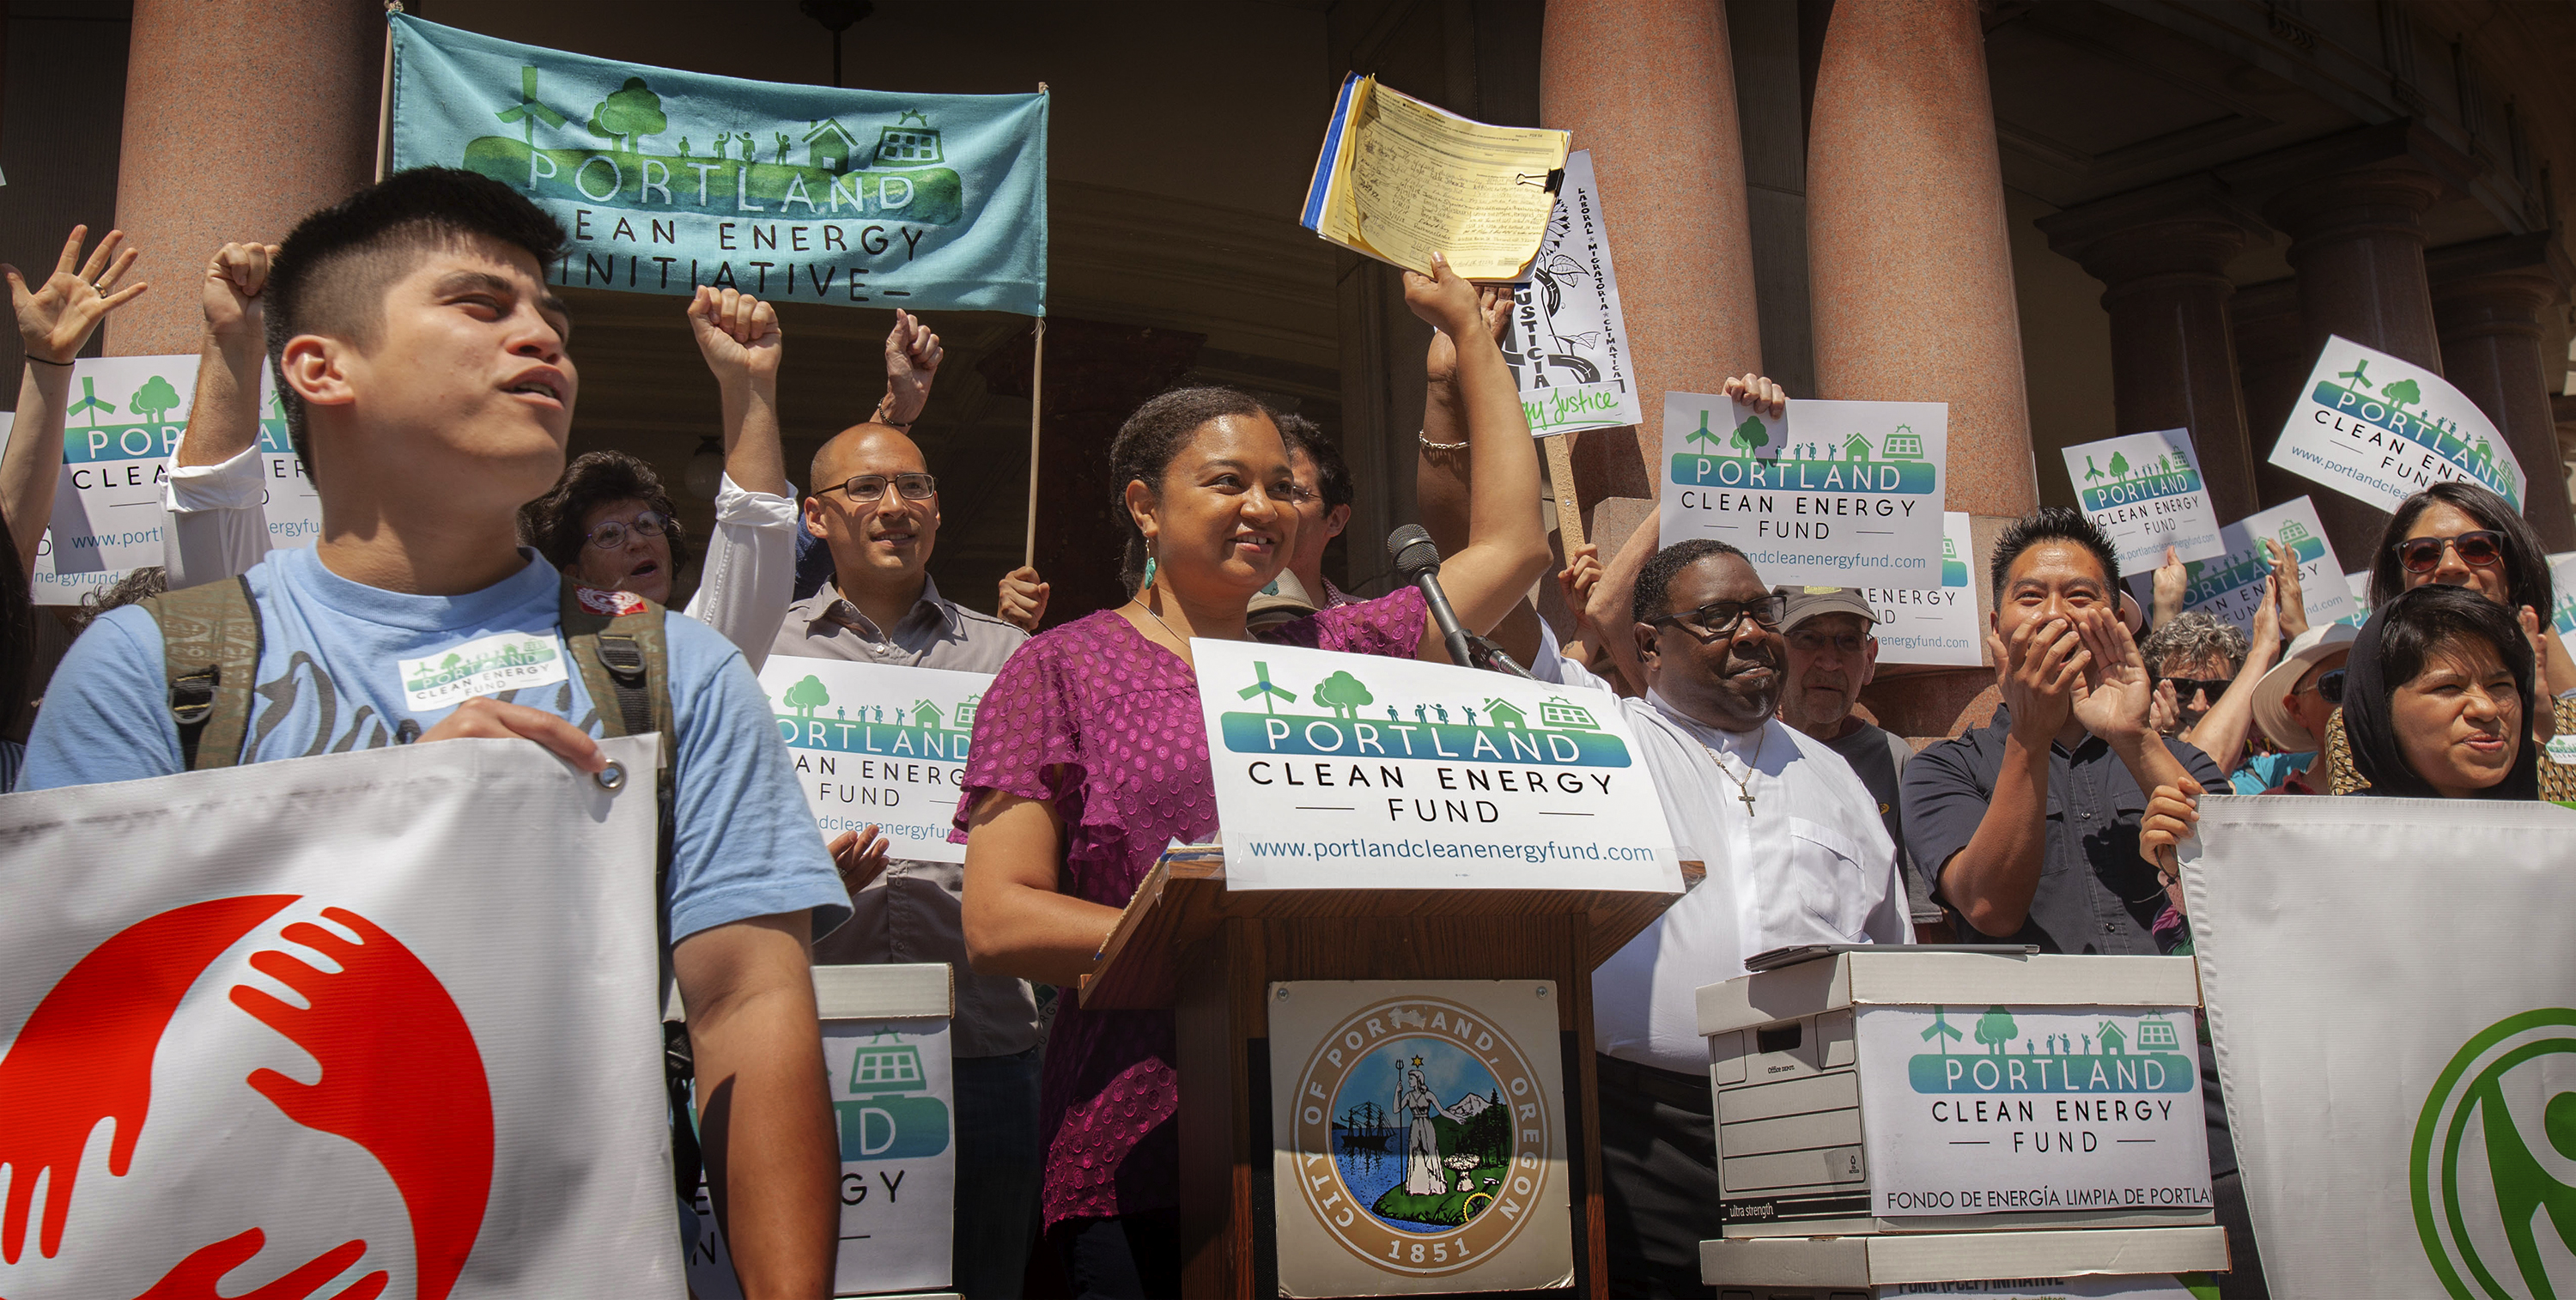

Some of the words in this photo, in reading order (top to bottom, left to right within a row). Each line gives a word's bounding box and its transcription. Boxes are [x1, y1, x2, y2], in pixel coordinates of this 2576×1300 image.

[529, 149, 914, 213] PORTLAND
[574, 209, 675, 246] EAN
[720, 222, 924, 261] ENERGY
[1577, 187, 1594, 235] LABORAL
[1588, 244, 1608, 312] MIGRATORIA
[561, 256, 869, 303] INITIATIVE
[1514, 290, 1551, 389] USTICIA
[1549, 385, 1619, 425] Justice
[2314, 410, 2405, 455] CLEAN
[2421, 453, 2480, 487] ENE
[2336, 391, 2506, 496] PORTLAND
[1696, 458, 1901, 491] PORTLAND
[2291, 445, 2409, 501] www.portlandclea
[2381, 456, 2439, 488] FUN
[1681, 490, 1773, 514] CLEAN
[1796, 496, 1916, 518] ENERGY
[2096, 473, 2188, 507] PORTLAND
[2098, 505, 2148, 526] CLEAN
[2154, 495, 2199, 515] ENERGY
[2144, 518, 2177, 535] FUND
[1759, 520, 1830, 540] FUND
[1744, 549, 1927, 571] ndcleanenergyfund.com
[2183, 548, 2302, 605] ORTLA
[1868, 587, 1956, 606] ENERGY
[2222, 604, 2259, 624] FUN
[416, 677, 472, 700] CLEAN
[483, 663, 550, 683] ENERGY
[422, 653, 539, 689] PORTAND
[464, 680, 507, 696] FUND
[1265, 718, 1580, 763] PORTLAND
[862, 760, 965, 787] ENERG
[1249, 761, 1404, 788] CLEAN
[1438, 767, 1612, 796] ENERGY
[820, 782, 900, 807] FUND
[1388, 798, 1499, 824] FUND
[1250, 837, 1656, 864] www.portlandcleanenergyfund.com
[1945, 1059, 2166, 1090] PORTLAND
[1303, 1081, 1327, 1125] OF
[1931, 1100, 2033, 1122] CLEAN
[2057, 1099, 2172, 1122] ENERGY
[1498, 1076, 1540, 1222] OREGON
[2014, 1131, 2098, 1153] FUND
[1304, 1150, 1355, 1228] CITY
[1887, 1190, 1954, 1209] FONDO
[1961, 1191, 1982, 1207] DE
[1988, 1185, 2061, 1206] ENERGÍA
[2066, 1188, 2118, 1206] LIMPIA
[2124, 1188, 2144, 1205] DE
[1729, 1205, 1745, 1218] ultra
[1745, 1203, 1774, 1218] strength
[1388, 1237, 1471, 1264] 1851
